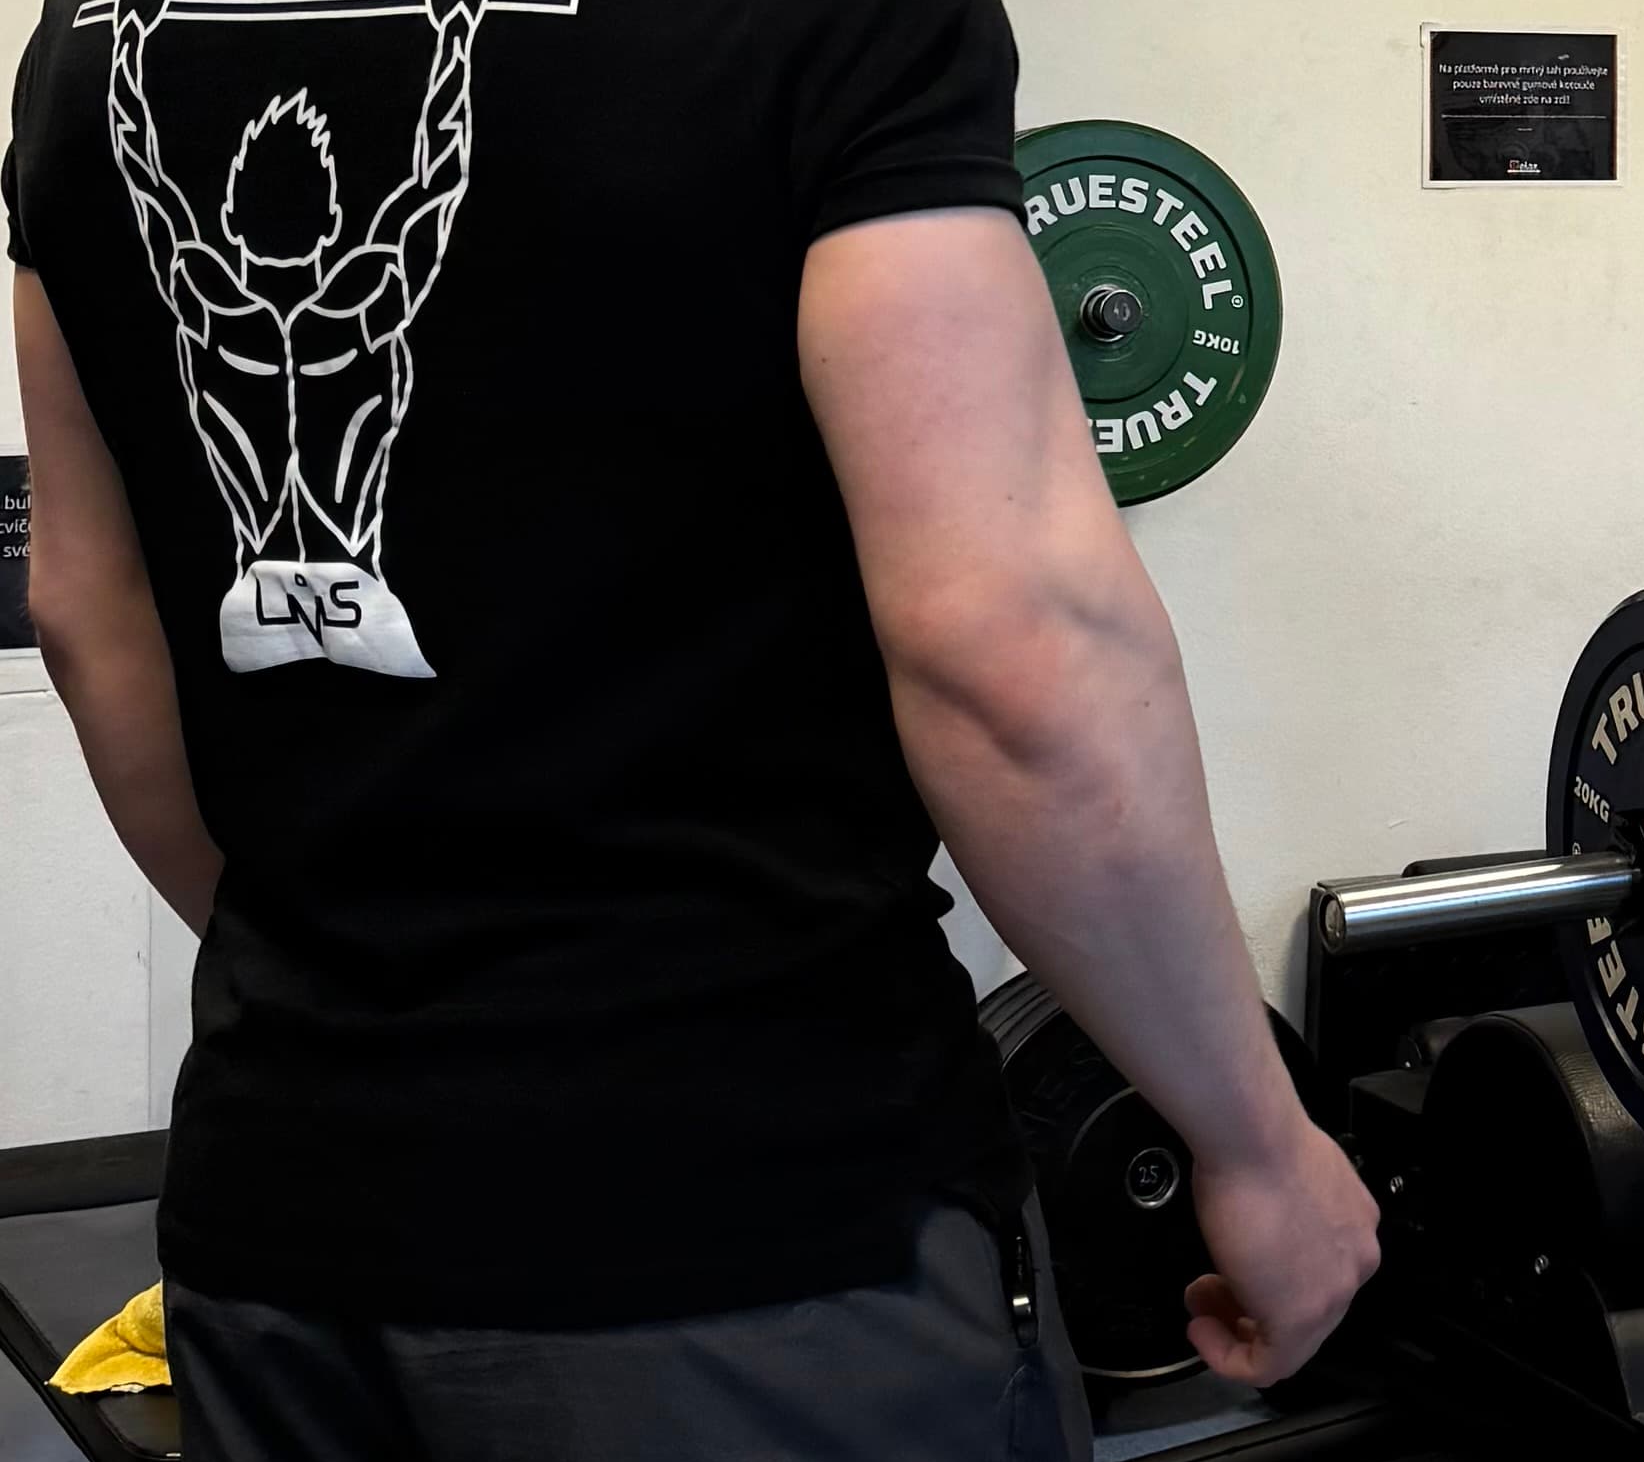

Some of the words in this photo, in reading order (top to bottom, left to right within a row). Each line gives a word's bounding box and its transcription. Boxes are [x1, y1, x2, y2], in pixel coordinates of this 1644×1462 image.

[1023, 174, 1234, 310] RUESTEEL
[1193, 329, 1240, 355] 10KG
[1573, 775, 1611, 824] 20KG
